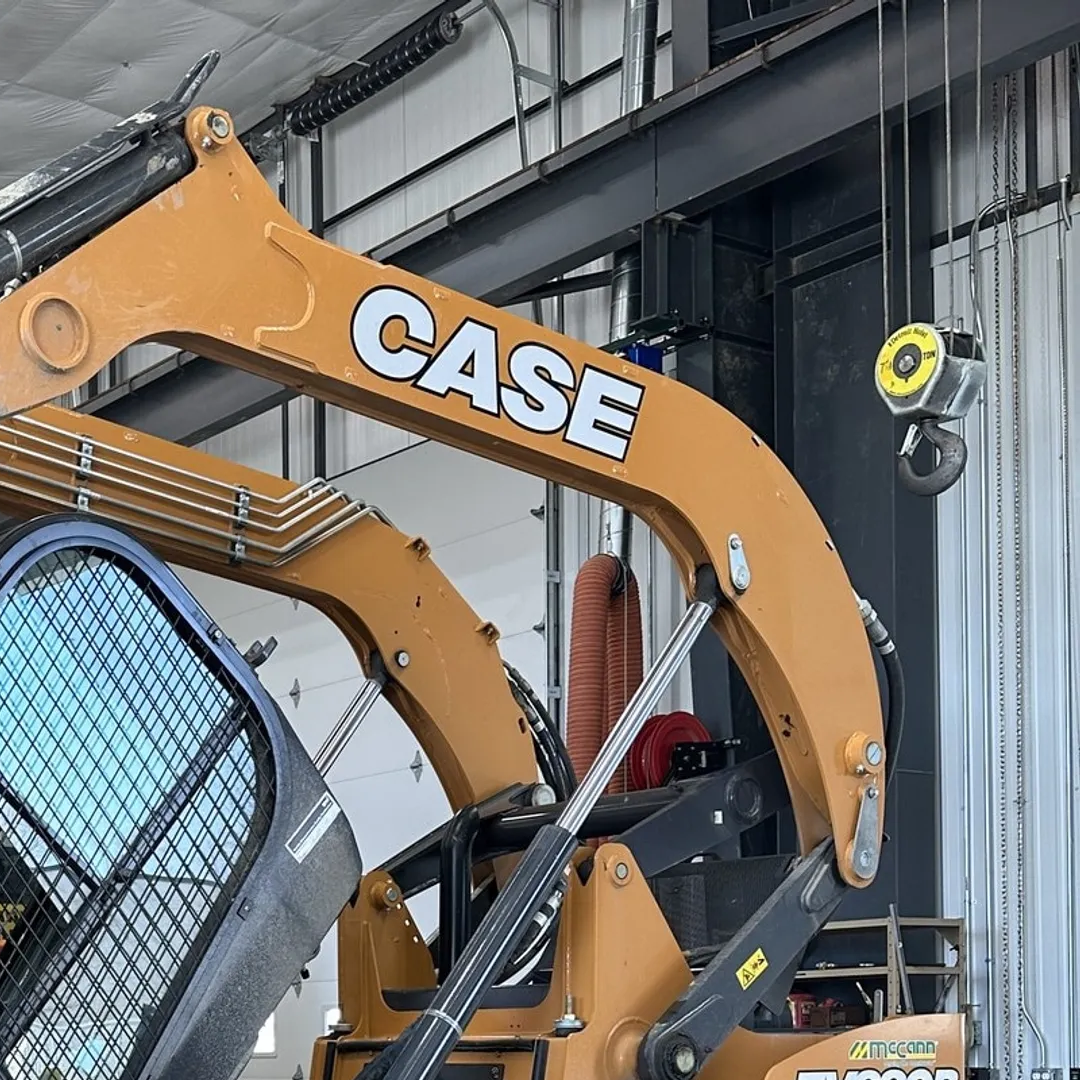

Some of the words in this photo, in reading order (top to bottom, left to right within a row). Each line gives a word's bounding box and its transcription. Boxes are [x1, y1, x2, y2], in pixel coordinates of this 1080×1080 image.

[890, 328, 913, 345] Detroit
[913, 327, 929, 338] Hoist
[923, 350, 936, 361] TON
[350, 284, 646, 463] CASE
